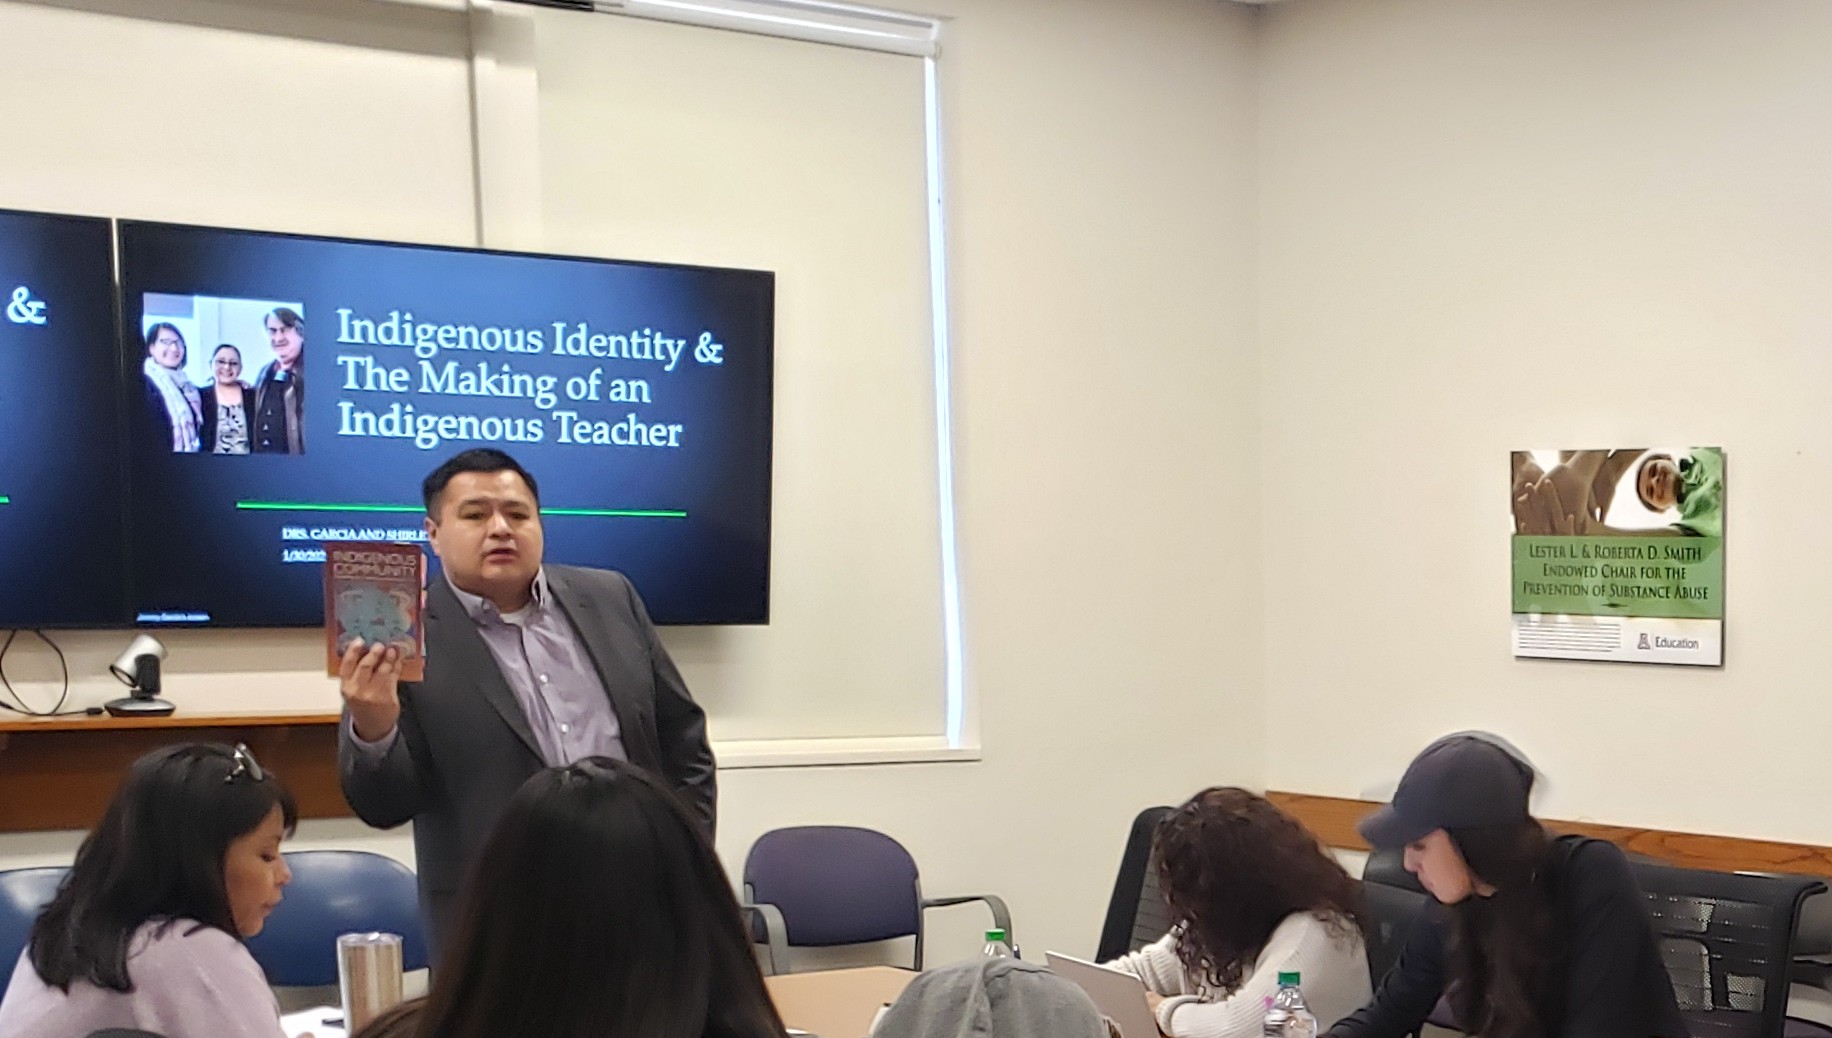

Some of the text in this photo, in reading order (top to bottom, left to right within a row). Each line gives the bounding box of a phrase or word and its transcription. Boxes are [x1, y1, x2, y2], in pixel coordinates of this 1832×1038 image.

[7, 286, 47, 325] &
[336, 308, 723, 371] Indigenous Identity &
[337, 355, 651, 409] The Making of an
[337, 402, 682, 449] Indigenous Teacher
[311, 529, 356, 540] GARCIA
[356, 529, 385, 540] AND
[387, 529, 429, 541] SHIRLE
[333, 551, 416, 566] INDIGENOUS
[1529, 544, 1566, 558] LESTER
[1582, 545, 1590, 559] &
[1595, 545, 1644, 559] ROBERTA
[1664, 546, 1701, 560] SMITH
[334, 564, 416, 576] COMMUNITY
[1543, 564, 1686, 580] ENDOWED CHAIR FOR THE
[1523, 582, 1708, 599] PREVENTION OF SUBSTANCE ABUSE
[1656, 637, 1699, 649] Education
